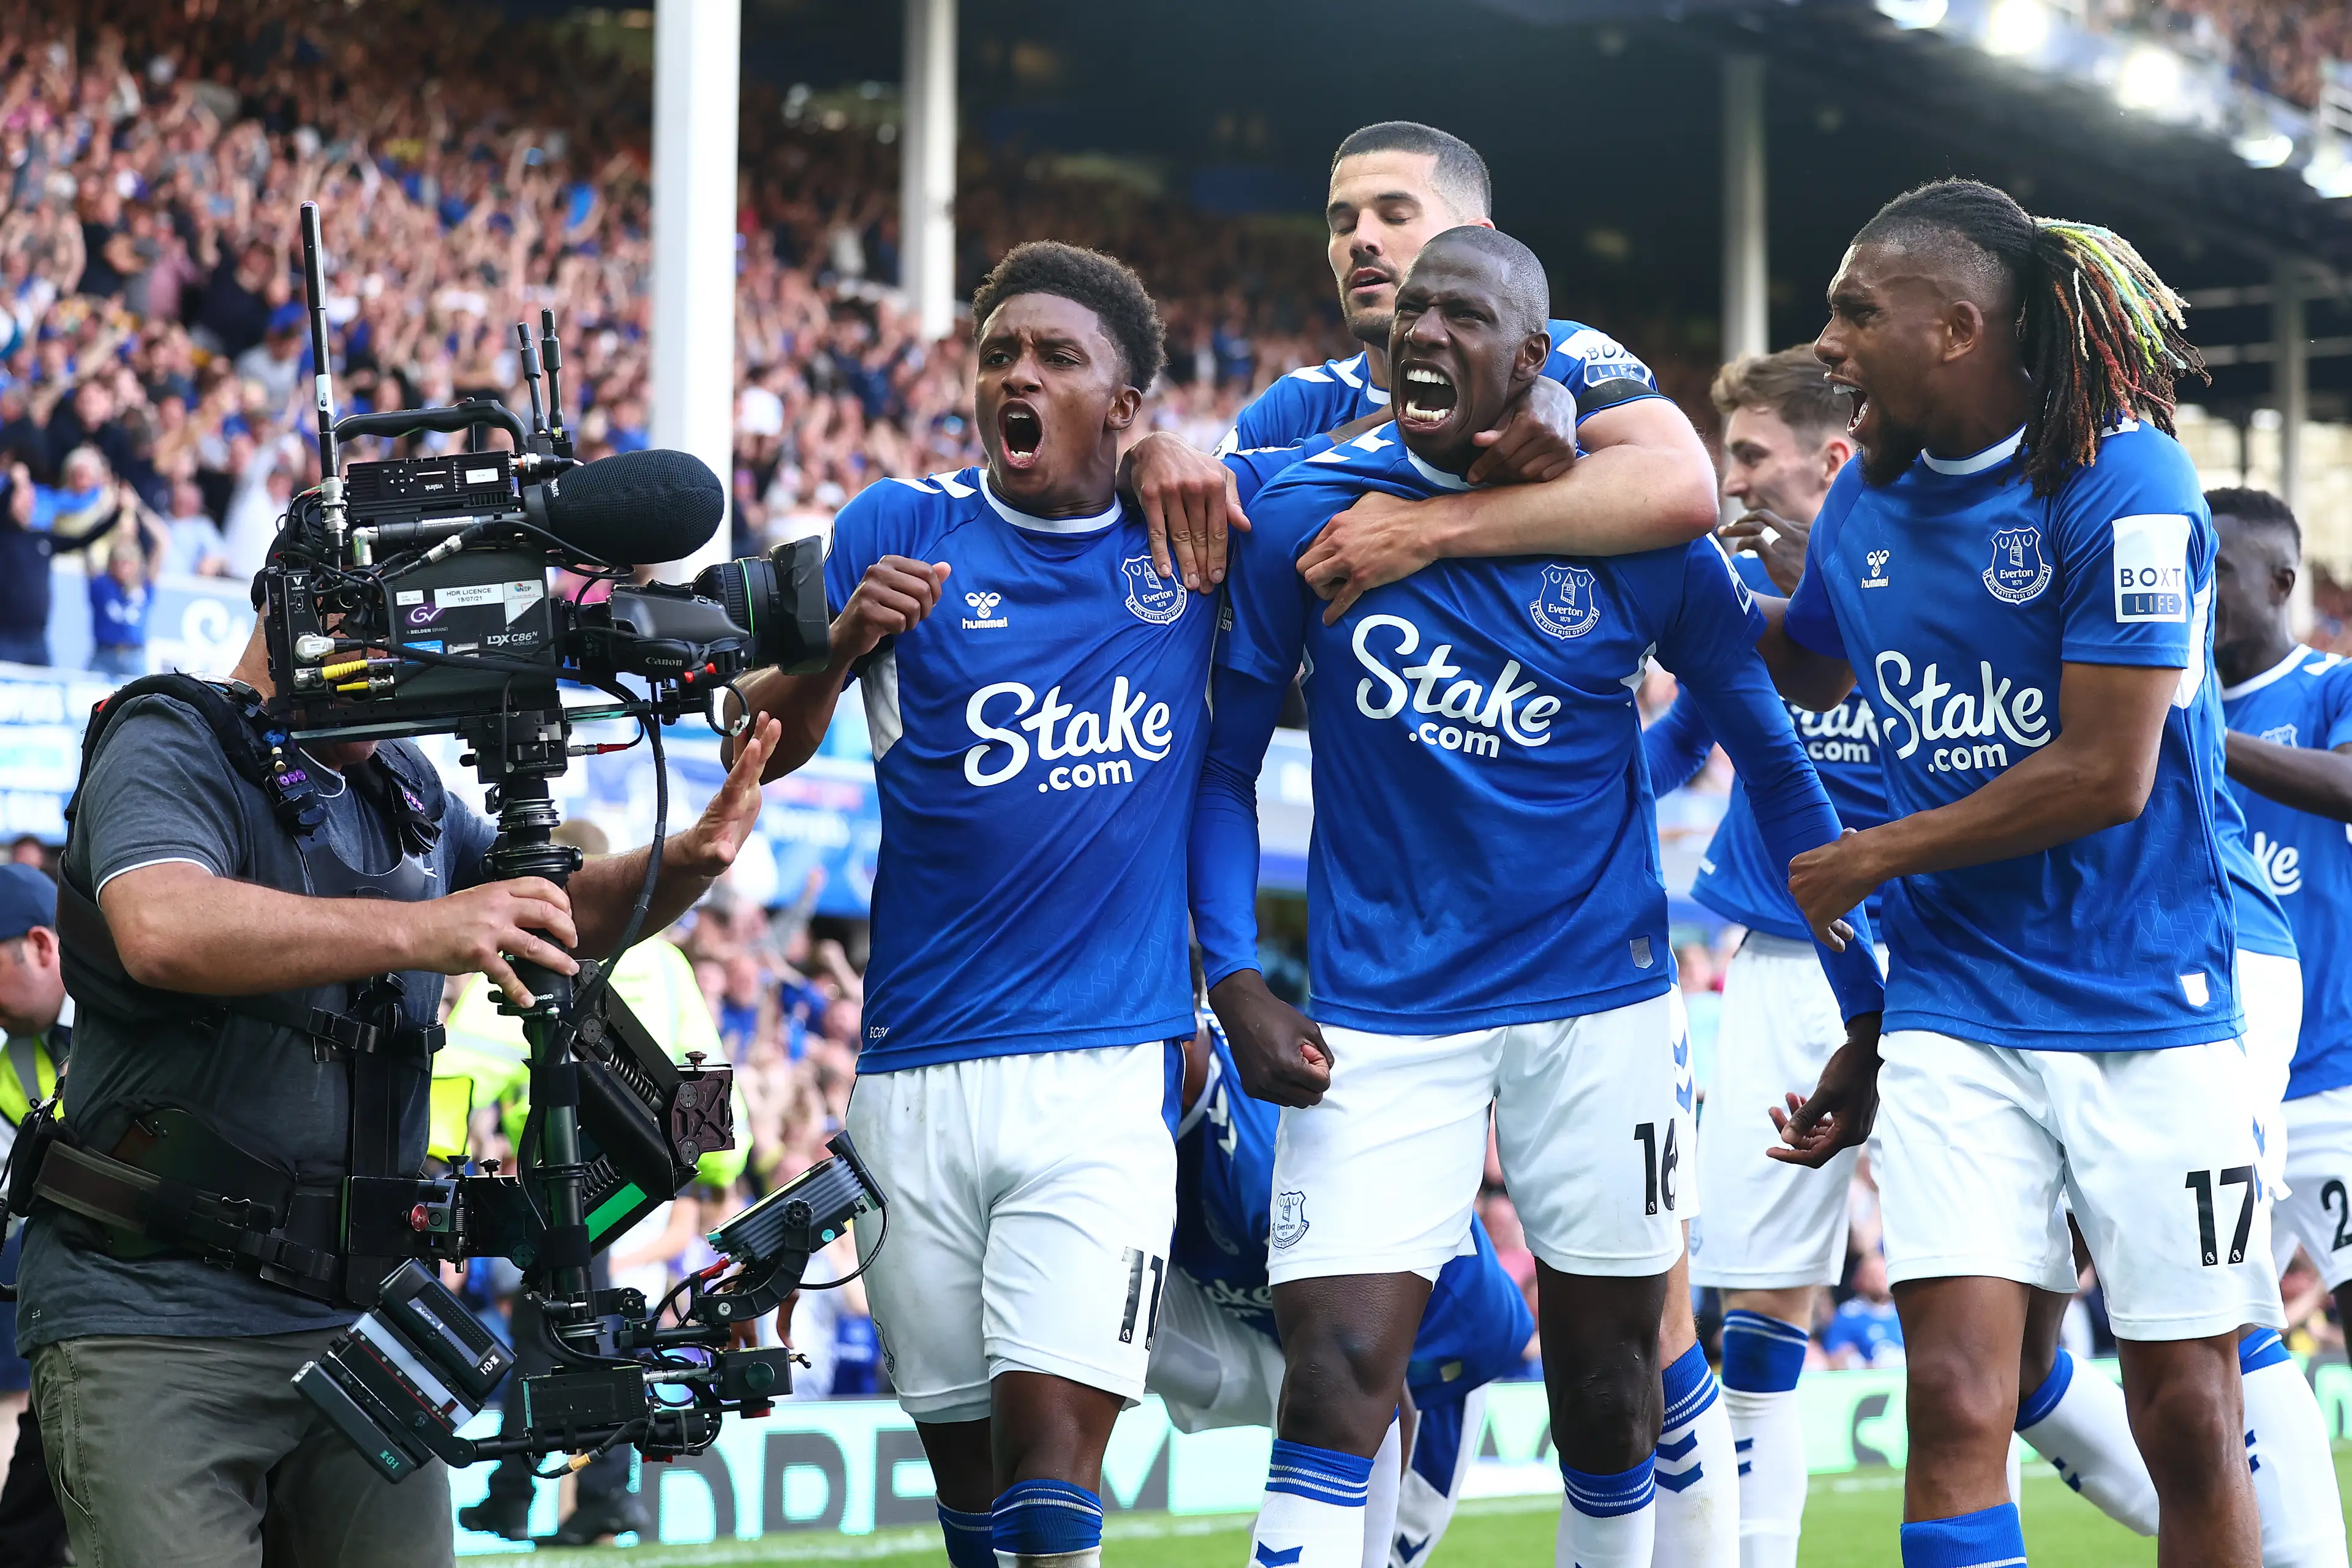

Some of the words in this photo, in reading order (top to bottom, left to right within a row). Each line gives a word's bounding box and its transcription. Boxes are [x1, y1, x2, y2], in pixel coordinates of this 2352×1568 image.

[1597, 364, 1638, 379] LIFE
[1861, 576, 1889, 589] hummel
[2000, 569, 2034, 579] Everton
[2120, 567, 2181, 587] BOXT
[1142, 589, 1174, 603] Everton
[1996, 589, 2011, 598] SATIS
[2027, 576, 2047, 596] OPTIMUM
[1134, 606, 1143, 616] NIL
[1172, 595, 1184, 616] OPTIMUM
[1548, 603, 1583, 617] Everton
[2135, 595, 2175, 612] LIFE
[962, 616, 1008, 629] hummel
[1541, 620, 1557, 633] SATIS
[1572, 619, 1594, 635] OPTIMUM
[487, 635, 510, 646] LDX
[645, 657, 683, 666] Canon
[1352, 614, 1561, 747] Stake
[1875, 650, 2051, 760] Stake
[965, 676, 1172, 787] Stake
[1409, 722, 1500, 759] .com
[1928, 742, 2008, 773] .com
[1038, 759, 1133, 793] .com
[1634, 1118, 1678, 1215] 16
[2184, 1164, 2256, 1266] 17
[1118, 1246, 1164, 1352] 11
